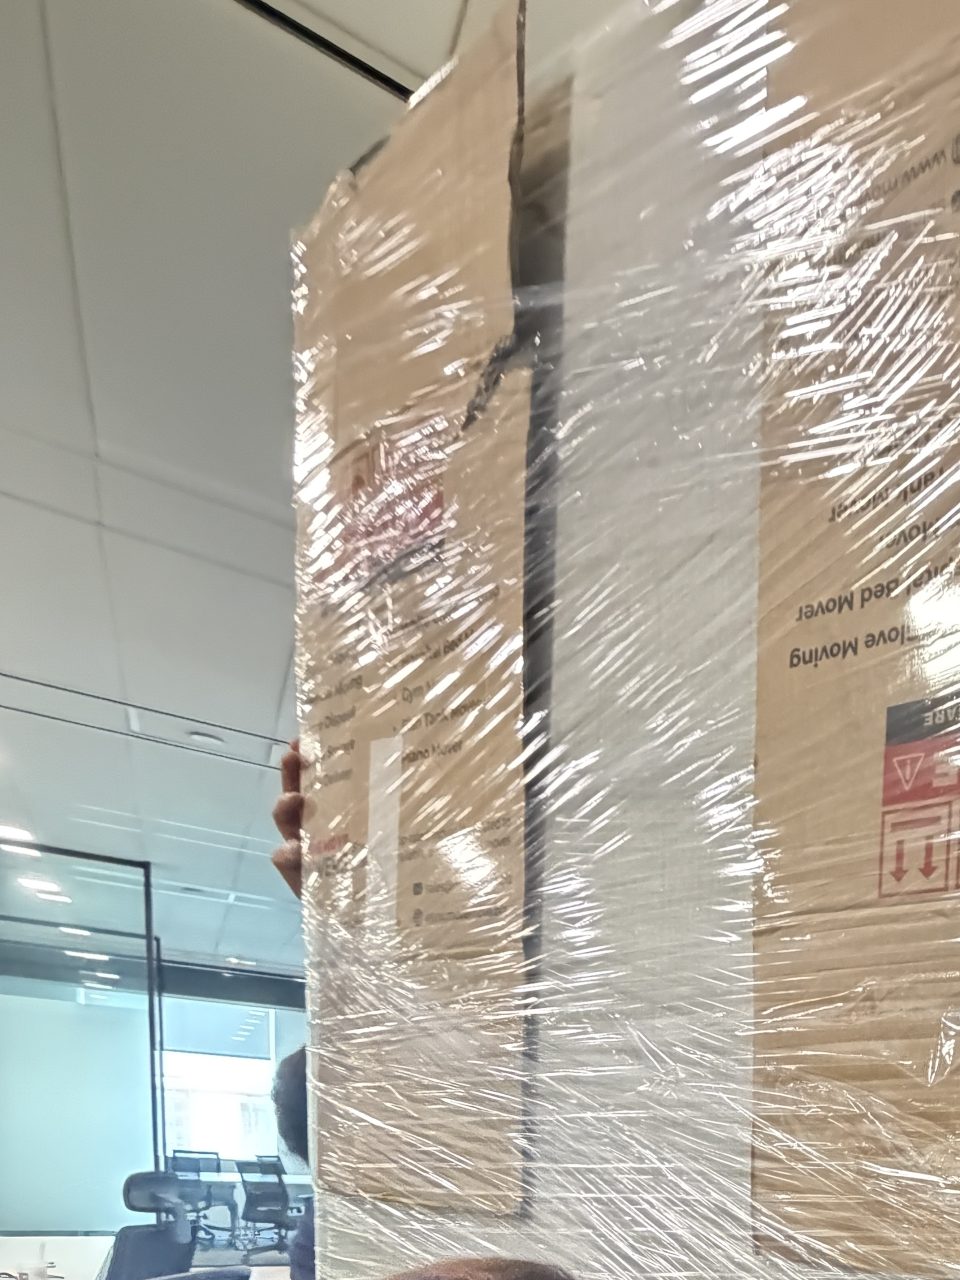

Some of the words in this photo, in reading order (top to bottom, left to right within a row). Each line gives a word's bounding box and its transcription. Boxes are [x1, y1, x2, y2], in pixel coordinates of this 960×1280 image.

[795, 594, 854, 624] Mover
[860, 578, 899, 609] Bed
[788, 637, 859, 669] Moving
